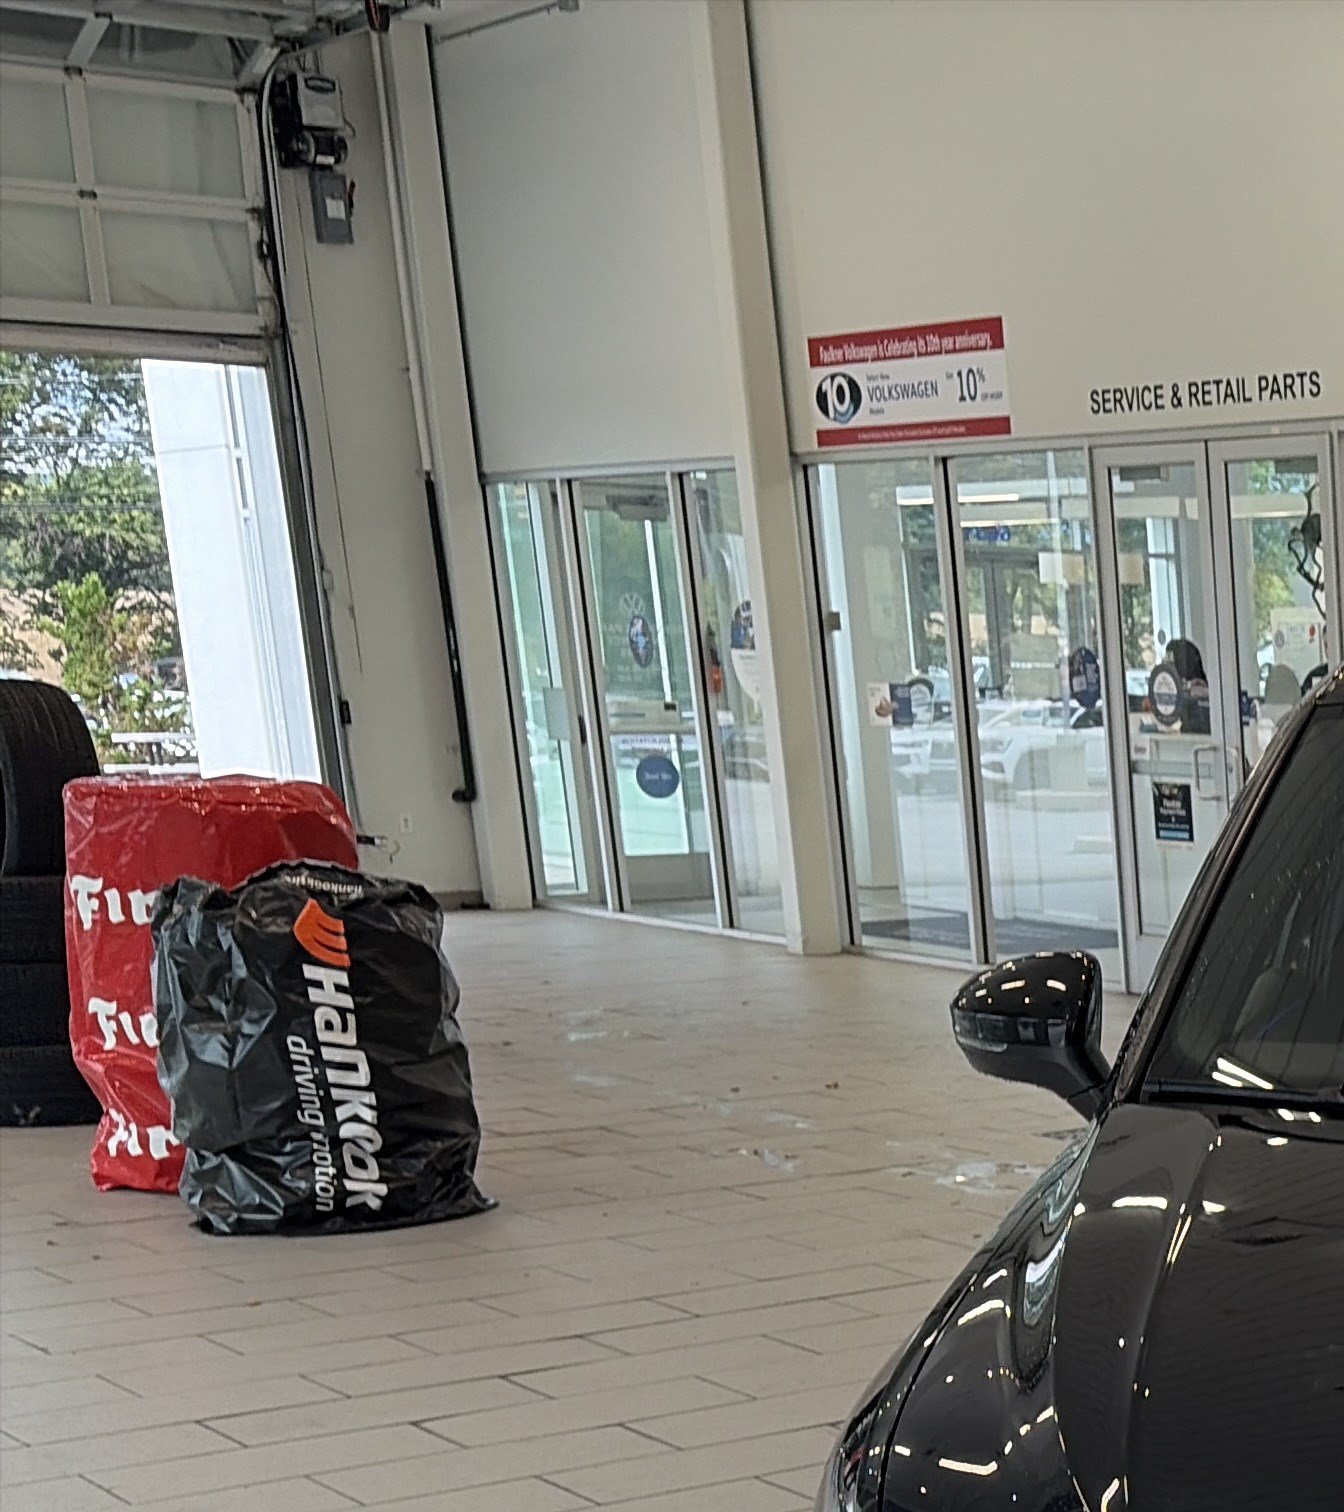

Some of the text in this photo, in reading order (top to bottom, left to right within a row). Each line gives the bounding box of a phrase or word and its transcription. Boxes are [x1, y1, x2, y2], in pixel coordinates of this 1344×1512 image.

[822, 374, 851, 421] 10
[866, 380, 939, 402] VOLKSWAGEN
[1090, 370, 1322, 415] SERVICE & RETAIL PARTS
[286, 1034, 325, 1127] driving
[302, 963, 389, 1211] Hankook
